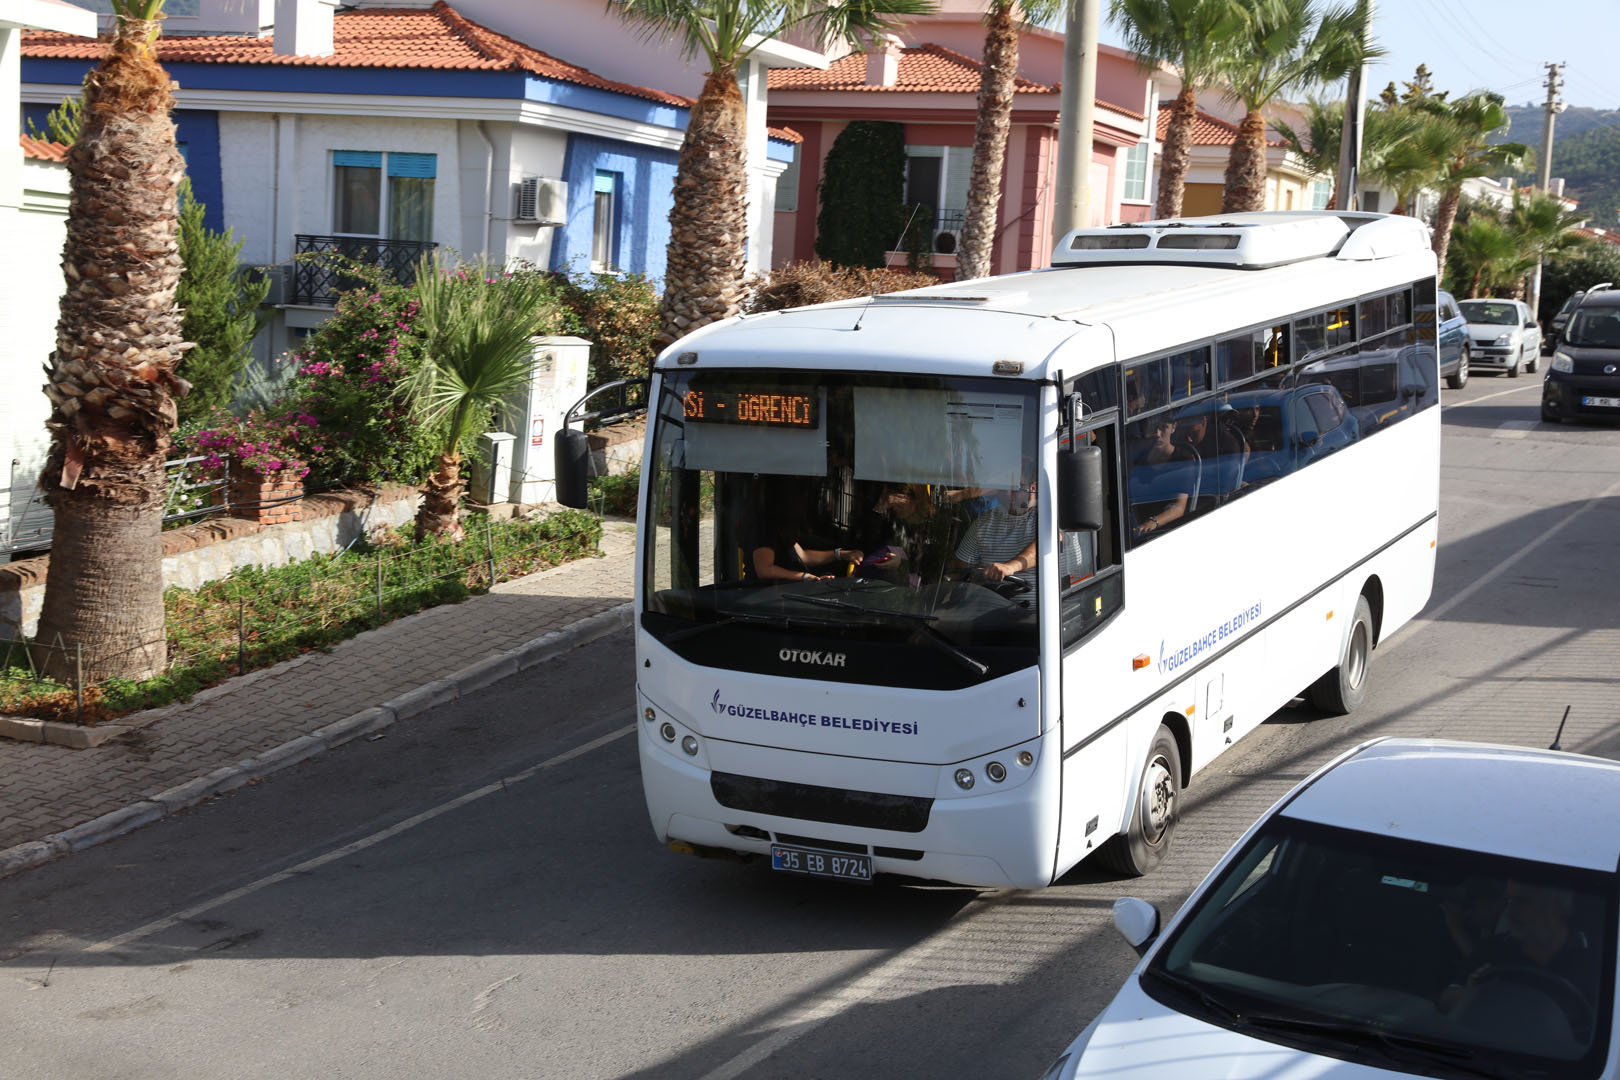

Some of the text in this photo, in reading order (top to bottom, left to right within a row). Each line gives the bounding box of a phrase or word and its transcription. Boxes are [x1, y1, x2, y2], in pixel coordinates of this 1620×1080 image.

[737, 393, 810, 424] ÖĞRENCİ
[1168, 598, 1262, 671] GÜZELBAHÇE BELEDİYESİ
[779, 648, 847, 667] OTOKAR
[727, 703, 918, 735] GÜZELBAHÇE BELEDİYESİ
[782, 850, 867, 877] 35 EB 8724
